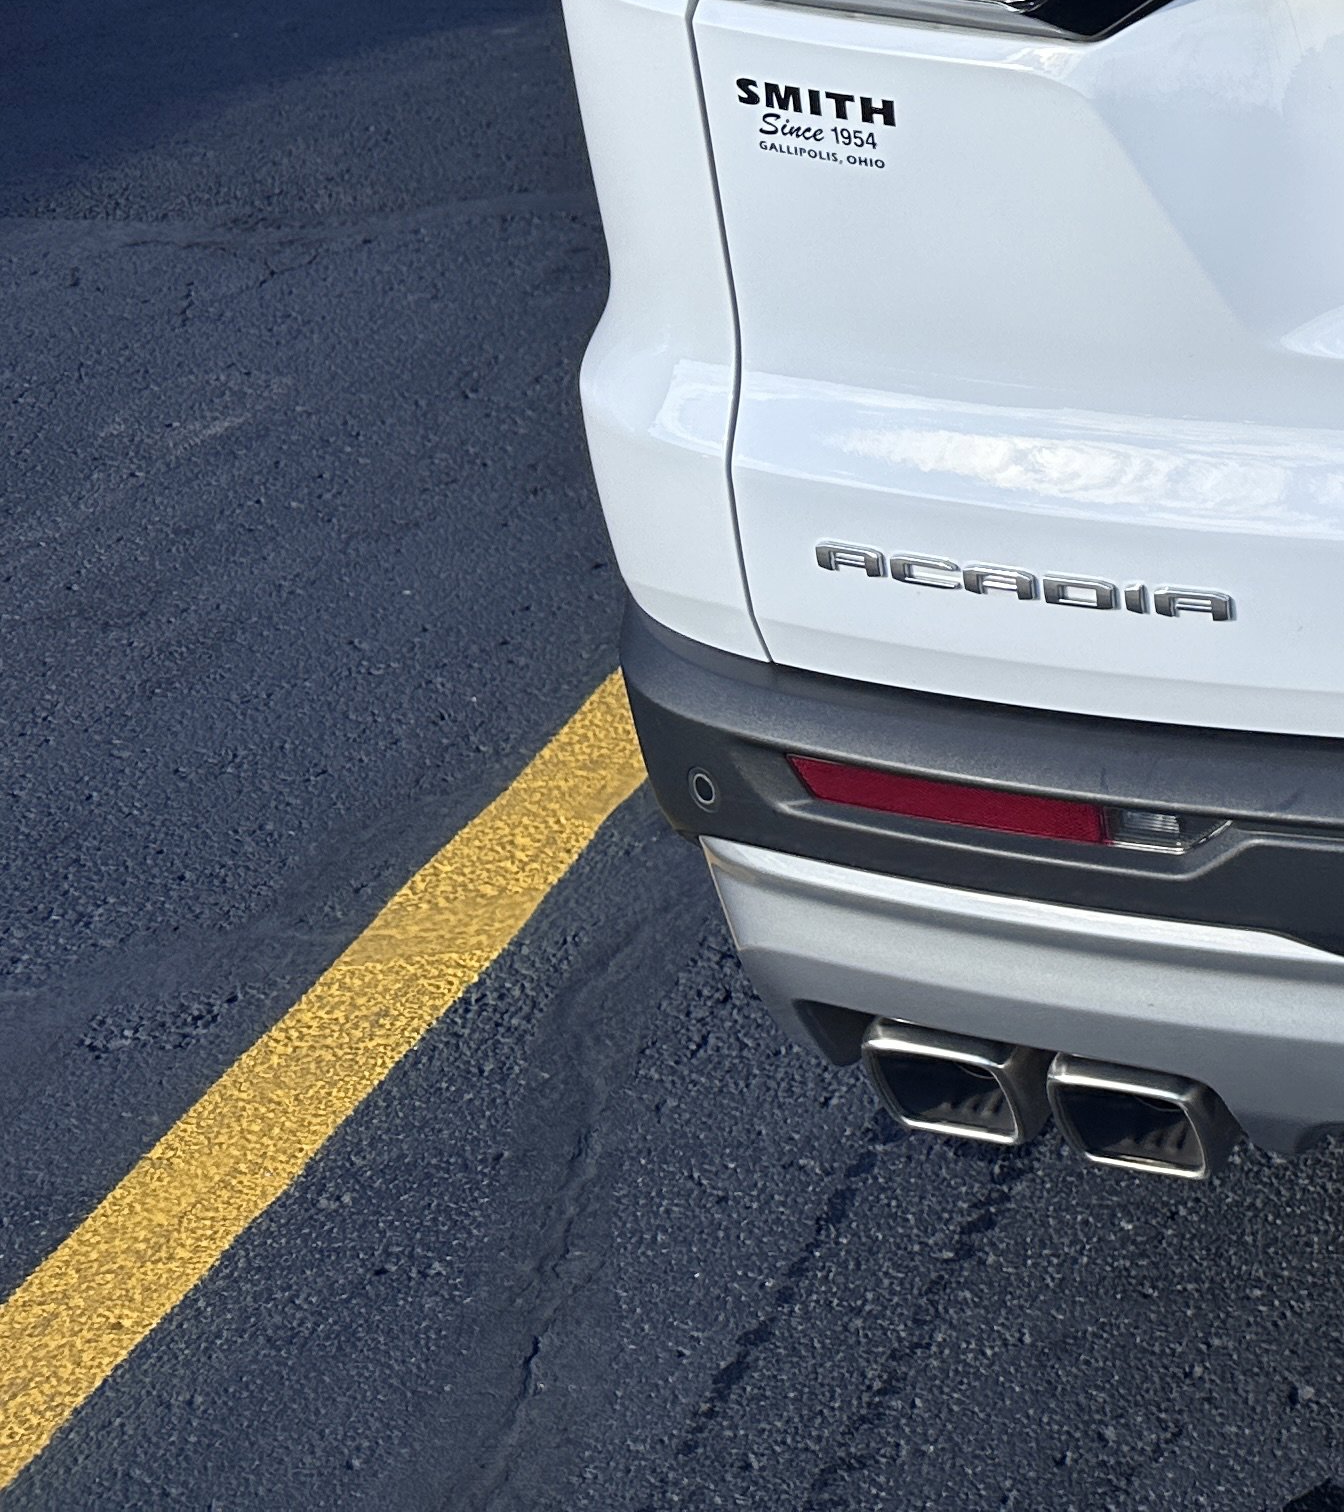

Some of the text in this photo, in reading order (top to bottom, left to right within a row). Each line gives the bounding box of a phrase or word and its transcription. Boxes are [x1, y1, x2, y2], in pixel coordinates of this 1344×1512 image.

[736, 77, 896, 127] SMITH
[759, 113, 878, 150] Since 1954
[759, 141, 885, 169] GALLIPOLIS, OHIO
[815, 538, 1237, 622] ACADIA
